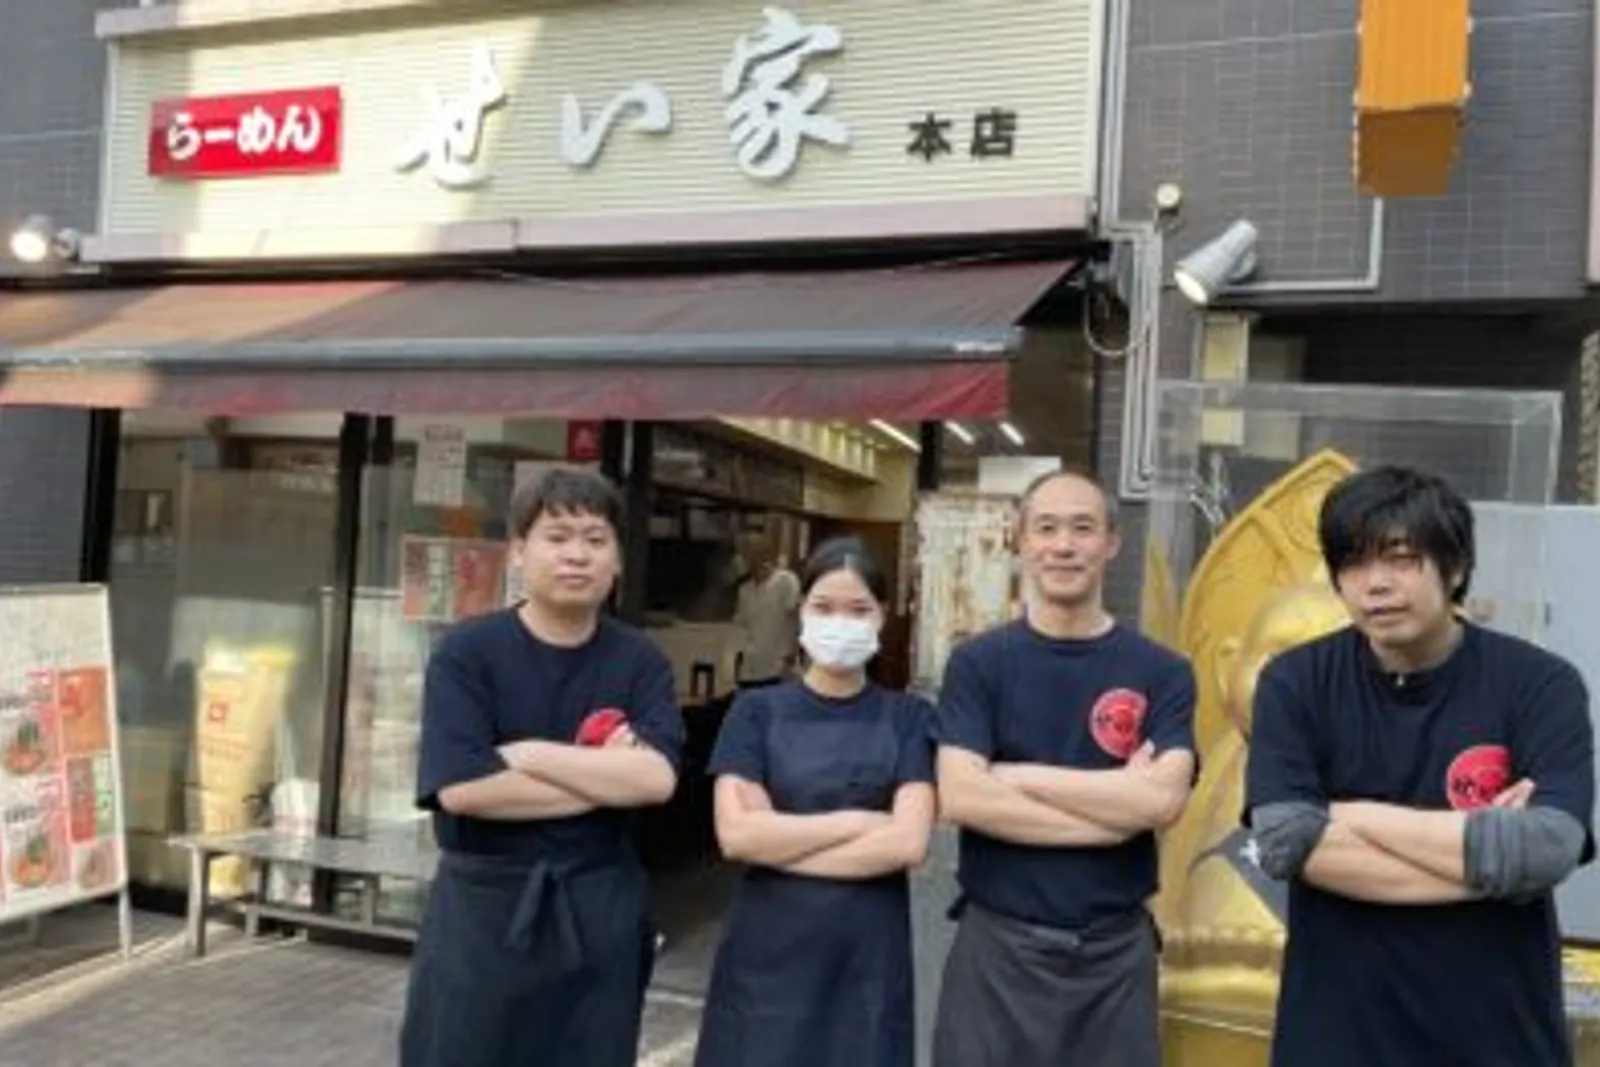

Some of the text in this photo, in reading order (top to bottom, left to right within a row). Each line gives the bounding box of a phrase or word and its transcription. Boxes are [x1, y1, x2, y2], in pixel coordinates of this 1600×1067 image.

[164, 102, 322, 161] らーめん
[396, 6, 1019, 188] せい家 本店
